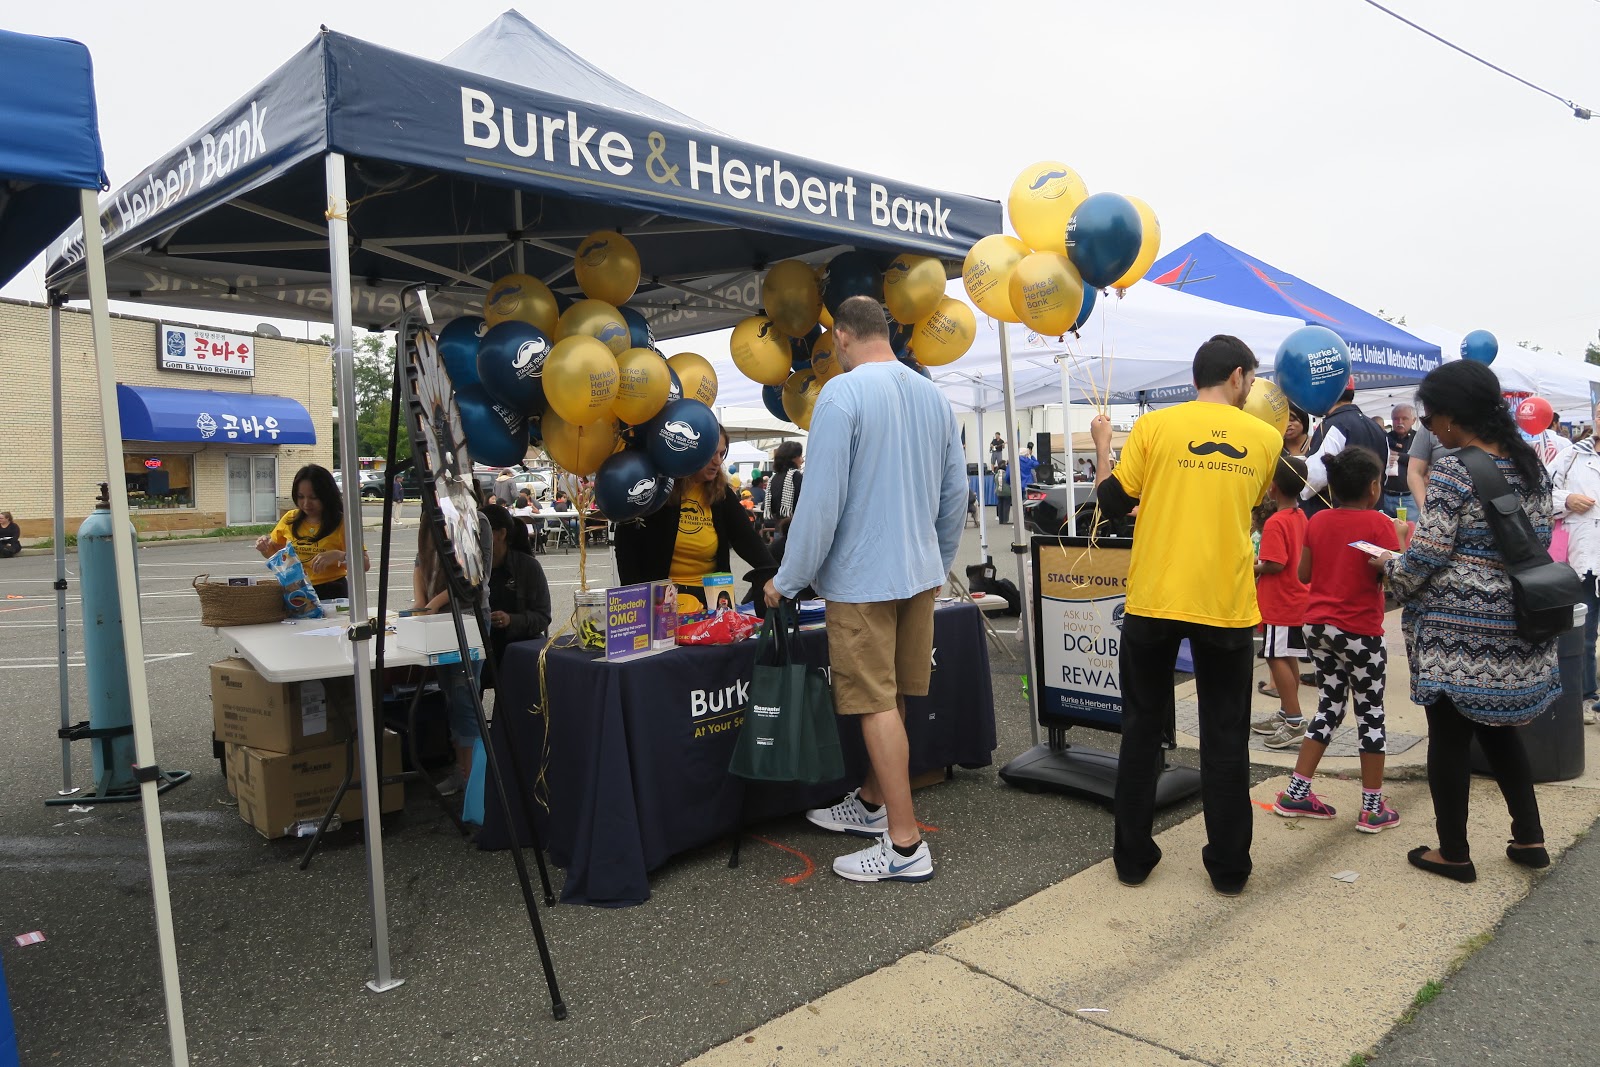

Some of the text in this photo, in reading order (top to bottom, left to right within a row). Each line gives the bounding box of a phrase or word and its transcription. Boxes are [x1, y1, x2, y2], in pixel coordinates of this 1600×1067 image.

[116, 145, 196, 232] Herbert
[200, 100, 268, 189] Bank
[461, 86, 955, 241] Burke & Herbert Bank
[1023, 277, 1054, 293] Burke &
[1025, 284, 1059, 301] Herbert
[1027, 298, 1049, 308] Bank
[926, 320, 942, 334] Bank
[931, 315, 955, 335] Herbert
[193, 337, 250, 364] 곰바우
[1308, 346, 1338, 361] Burke &
[1363, 344, 1386, 366] United
[1387, 347, 1418, 370] Methodist
[1309, 353, 1341, 368] Herbert
[197, 364, 213, 372] Woo
[215, 367, 251, 376] Restaurant
[590, 371, 611, 381] Burke
[641, 368, 647, 376] &
[1310, 364, 1333, 375] Bank
[591, 387, 610, 397] Bank
[222, 414, 281, 439] 곰바우
[1211, 430, 1227, 439] WE
[1177, 459, 1255, 477] YOU A QUESTION
[1047, 573, 1085, 585] STACHE
[1087, 576, 1119, 587] YOUR
[609, 597, 621, 605] Un-
[609, 599, 647, 613] expectedly
[609, 610, 637, 627] OMG!
[1063, 610, 1094, 621] ASK US
[1063, 622, 1101, 634] HOW TO
[1063, 633, 1118, 657] DOUB
[1087, 657, 1114, 669] YOUR
[1062, 665, 1120, 690] REWA
[690, 678, 750, 717] Burk
[1061, 695, 1079, 704] Burke
[1085, 699, 1111, 710] Herbert
[694, 726, 706, 738] At
[707, 721, 732, 734] Your
